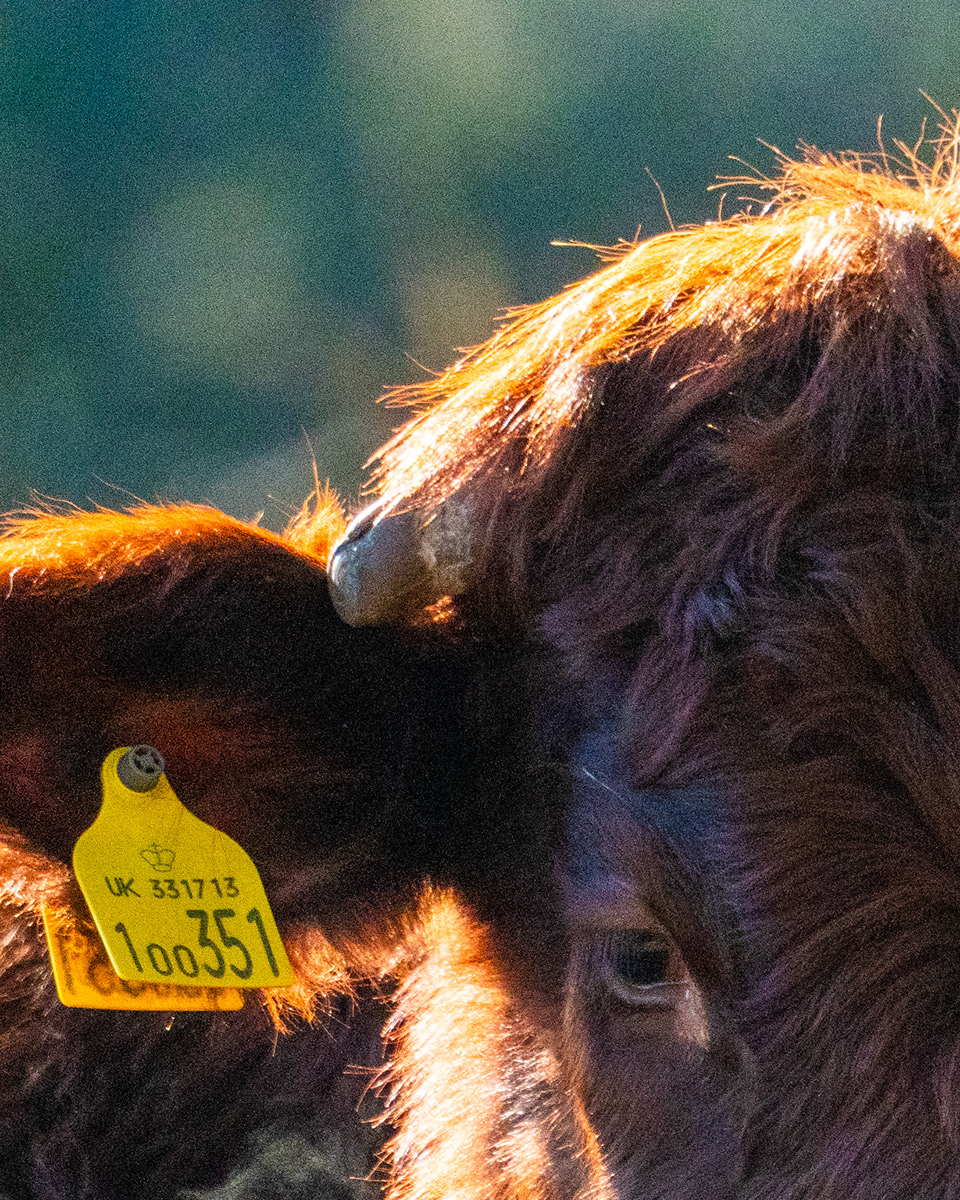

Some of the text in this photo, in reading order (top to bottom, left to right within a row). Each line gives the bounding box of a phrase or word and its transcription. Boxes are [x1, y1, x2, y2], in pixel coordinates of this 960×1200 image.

[105, 877, 240, 899] UK 331713
[115, 908, 279, 979] 100351
